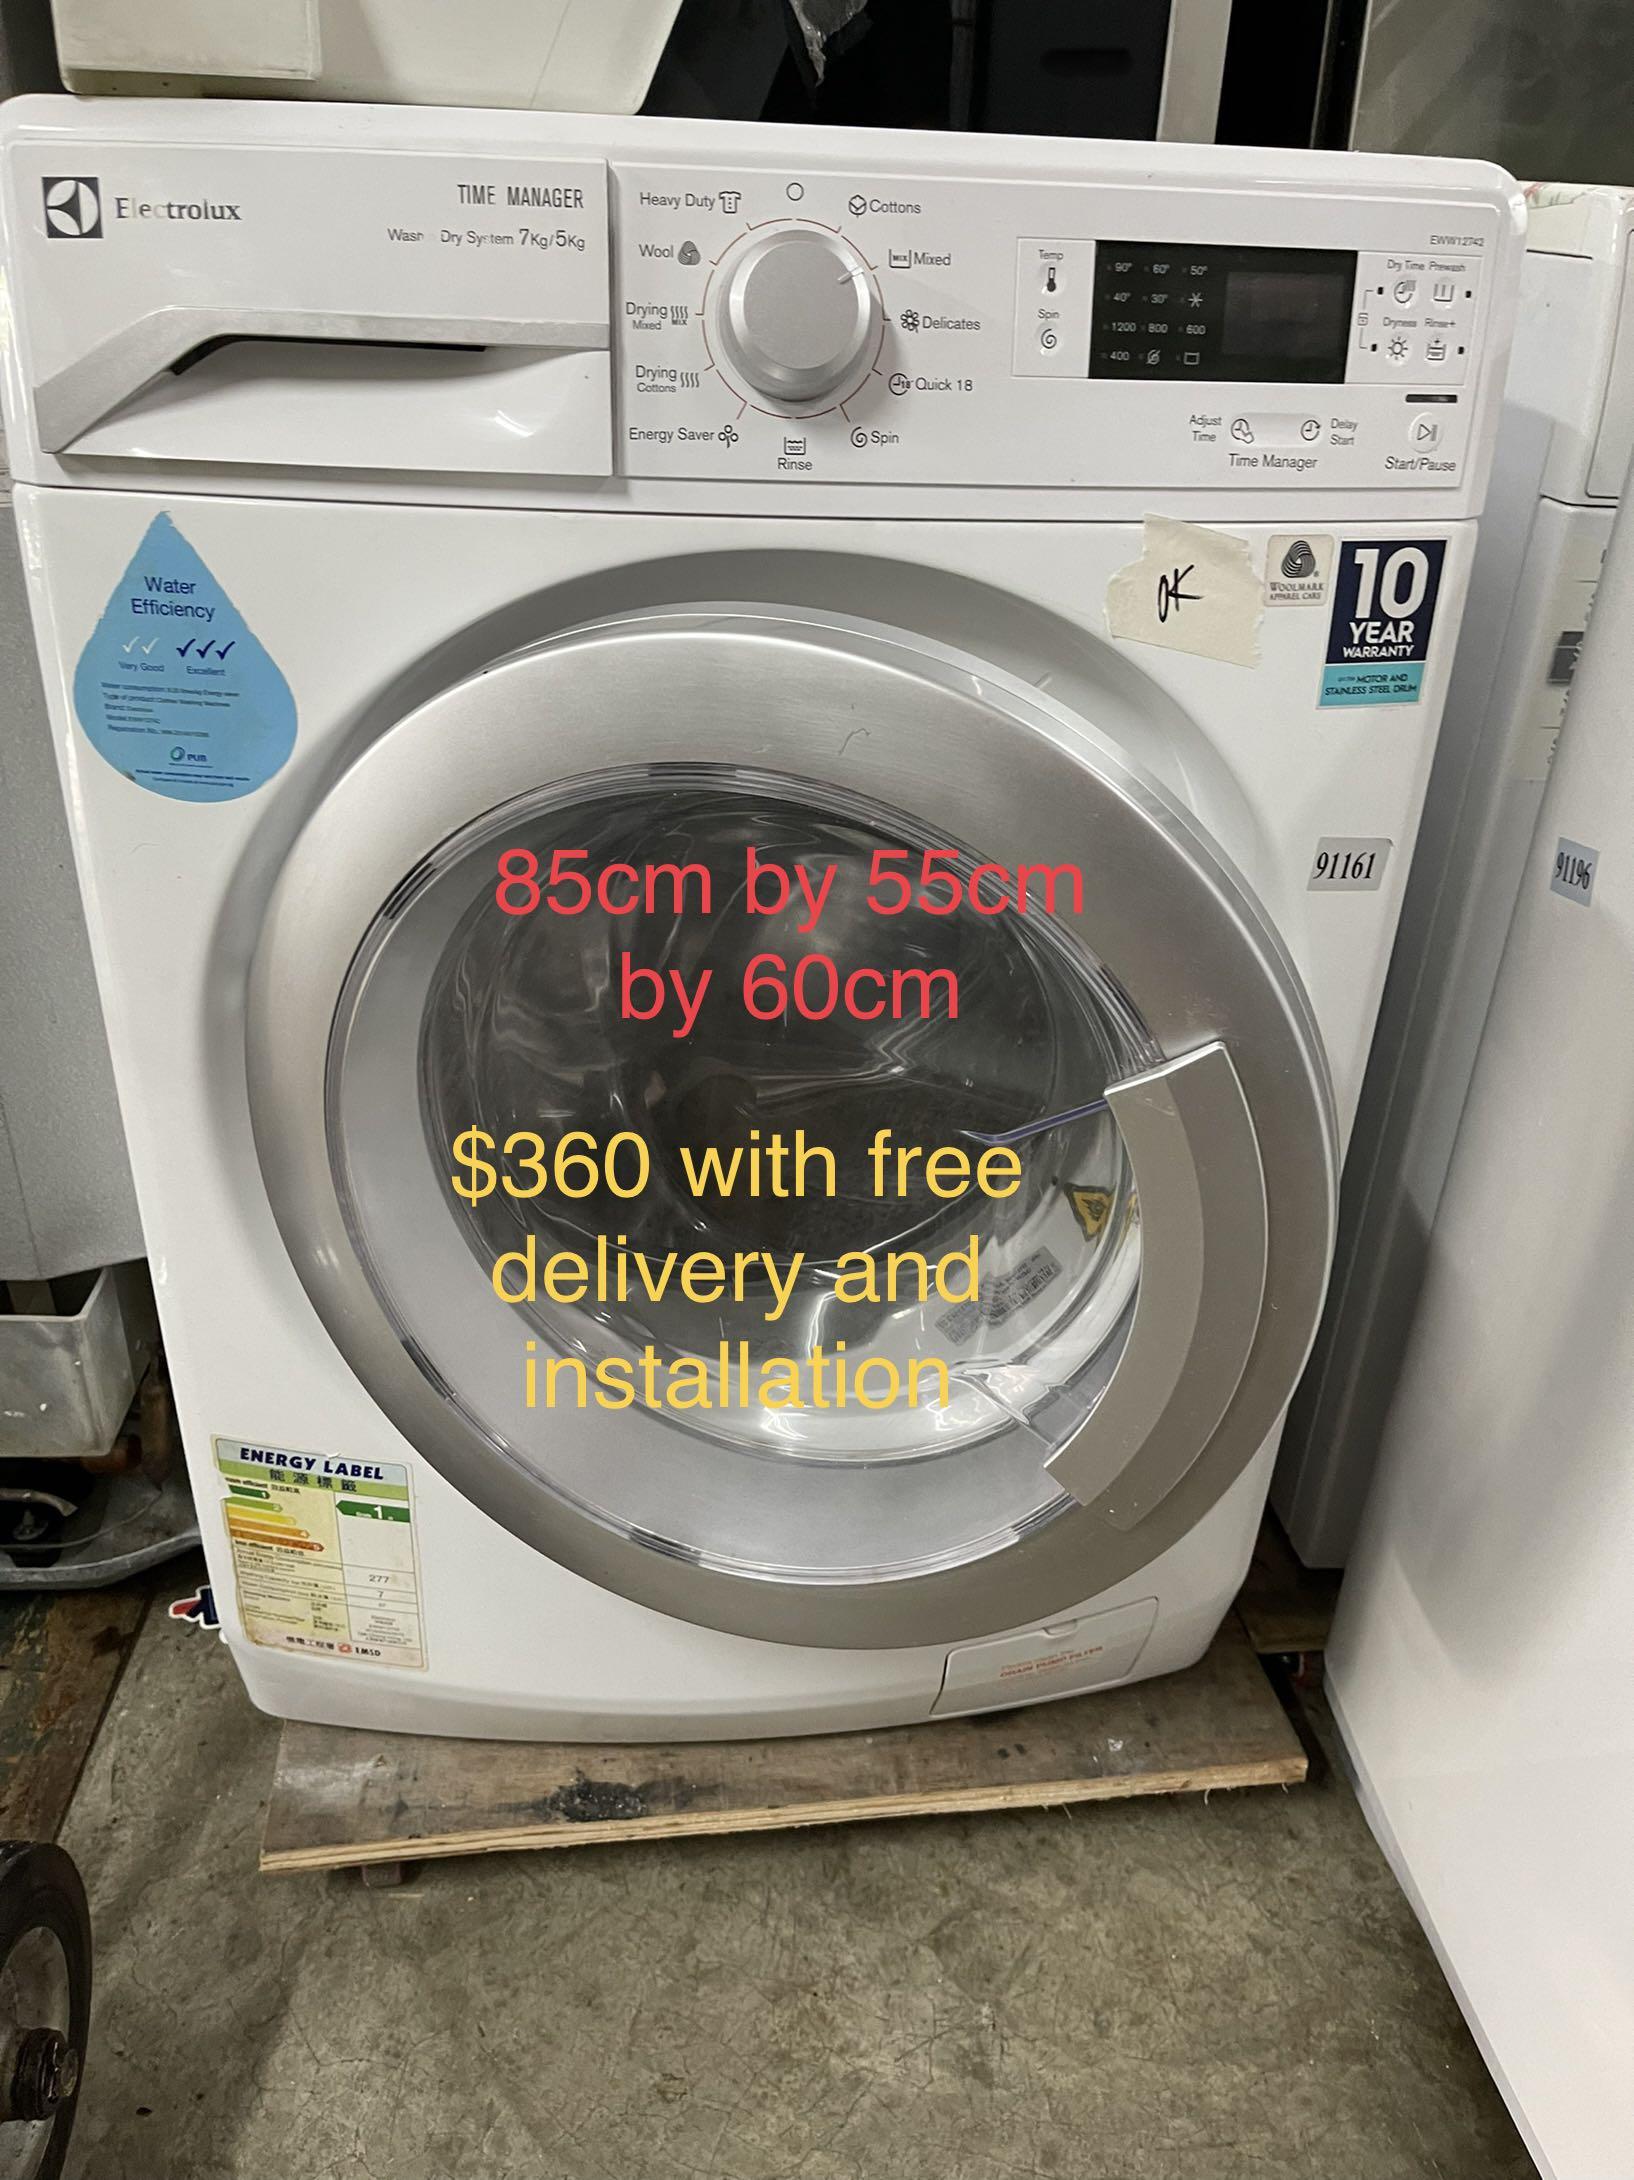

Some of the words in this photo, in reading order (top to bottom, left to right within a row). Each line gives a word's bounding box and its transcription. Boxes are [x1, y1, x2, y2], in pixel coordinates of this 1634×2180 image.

[457, 184, 496, 205] TIME
[507, 186, 585, 209] MANAGER
[639, 192, 682, 210] Heavy
[685, 193, 716, 211] Duty
[113, 196, 243, 221] Electrolux
[869, 199, 922, 214] Cottons
[440, 229, 463, 247] Dry
[638, 243, 674, 259] Wool
[913, 251, 952, 266] Mixed
[1038, 248, 1064, 261] Temp
[1386, 259, 1402, 272] Dry
[1404, 260, 1425, 271] Time
[625, 301, 669, 320] Drying
[1038, 308, 1060, 321] Spin
[632, 319, 662, 331] Mixed
[922, 315, 981, 331] Delicates
[1110, 321, 1137, 333] 1200
[1109, 350, 1130, 362] 400
[635, 364, 677, 383] Drying
[636, 382, 677, 393] Cottons
[915, 376, 952, 391] Quick
[957, 378, 973, 392] 18
[1189, 414, 1222, 428] Adjust
[1330, 417, 1359, 432] Delay
[628, 426, 674, 444] Energy
[677, 426, 715, 441] Saver
[870, 430, 900, 447] Spin
[1191, 430, 1217, 442] Time
[1329, 434, 1355, 446] Start
[777, 457, 813, 471] Rinse
[1228, 452, 1258, 468] Time
[1261, 454, 1319, 472] Manager
[1384, 455, 1457, 472] Start/Pause
[143, 575, 197, 595] Water
[1353, 546, 1430, 620] 10
[1157, 564, 1206, 624] OK
[130, 597, 217, 623] Efficiency
[1348, 620, 1415, 645] YEAR
[1342, 645, 1415, 659] WARRANTY
[117, 660, 139, 673] Very
[140, 662, 165, 673] Good
[185, 665, 227, 677] Excellent
[1356, 673, 1389, 684] MOTOR
[1389, 673, 1409, 682] AND
[1324, 686, 1367, 696] STAINLESS
[1368, 685, 1391, 694] STEEL
[1392, 684, 1418, 693] DRUM
[186, 752, 208, 763] PUB
[1311, 851, 1377, 880] 91161
[1553, 851, 1594, 891] 91196
[239, 1446, 317, 1472] ENERGY
[323, 1459, 384, 1481] LABEL
[373, 1505, 383, 1520] 1
[368, 1574, 390, 1585] 277
